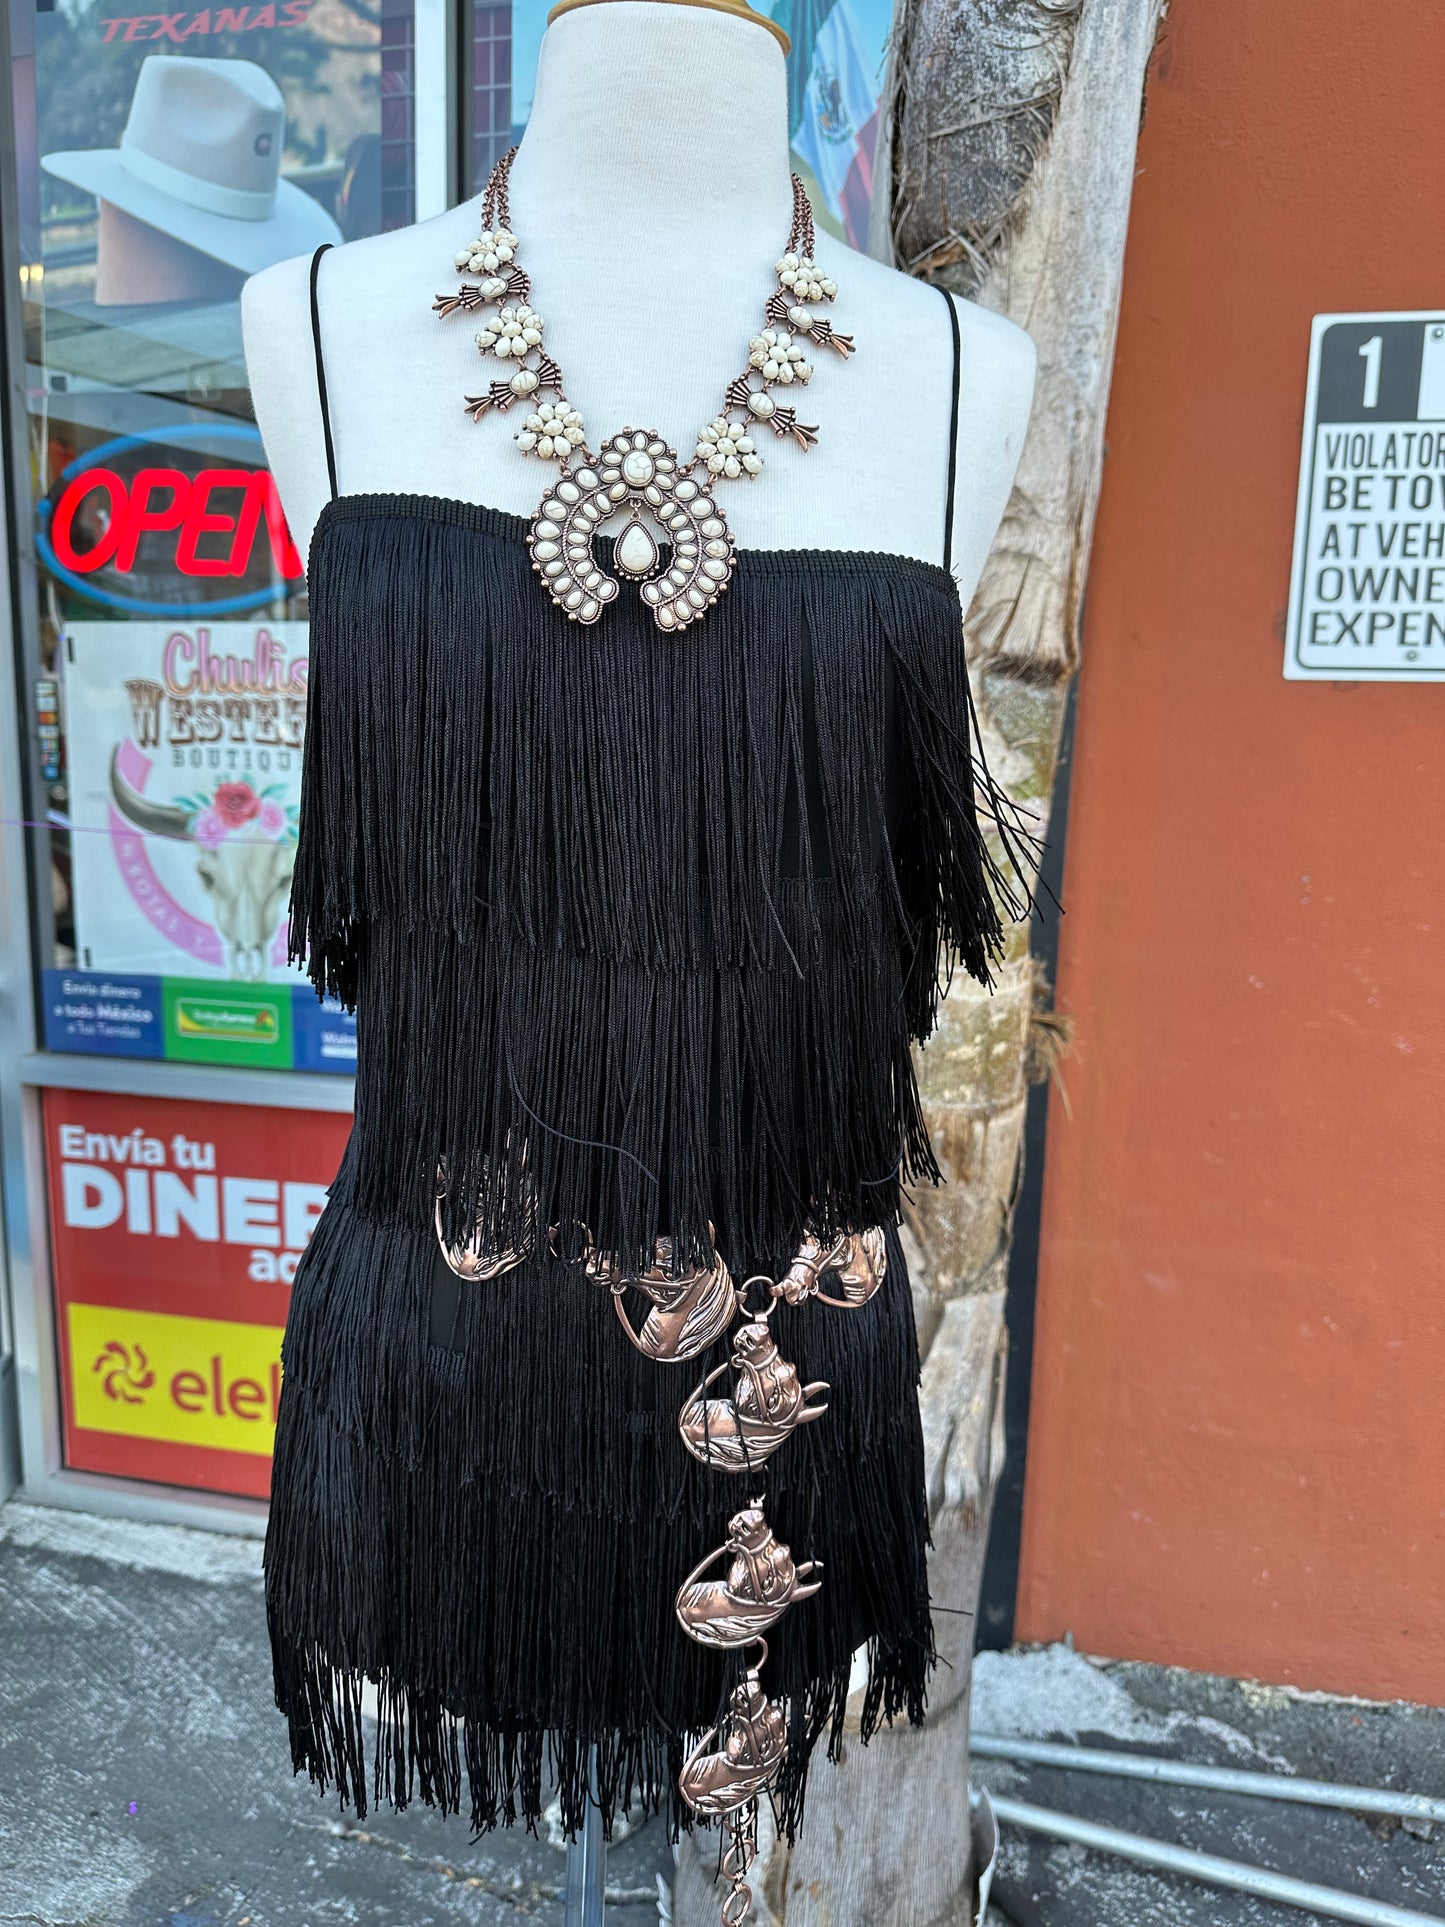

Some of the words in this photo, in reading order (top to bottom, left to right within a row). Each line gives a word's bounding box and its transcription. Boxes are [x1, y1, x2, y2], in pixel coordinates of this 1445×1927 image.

[101, 0, 312, 43] TEXANAS
[1358, 335, 1383, 409] 1
[1322, 475, 1374, 511] BE
[1382, 474, 1445, 511] TO
[52, 468, 304, 579] OPEN
[1319, 522, 1367, 559] AT
[1375, 522, 1445, 559] VEH
[1315, 566, 1445, 602] OWNE
[1308, 611, 1445, 649] EXPEN
[59, 1124, 164, 1167] Envía
[172, 1134, 216, 1170] tu
